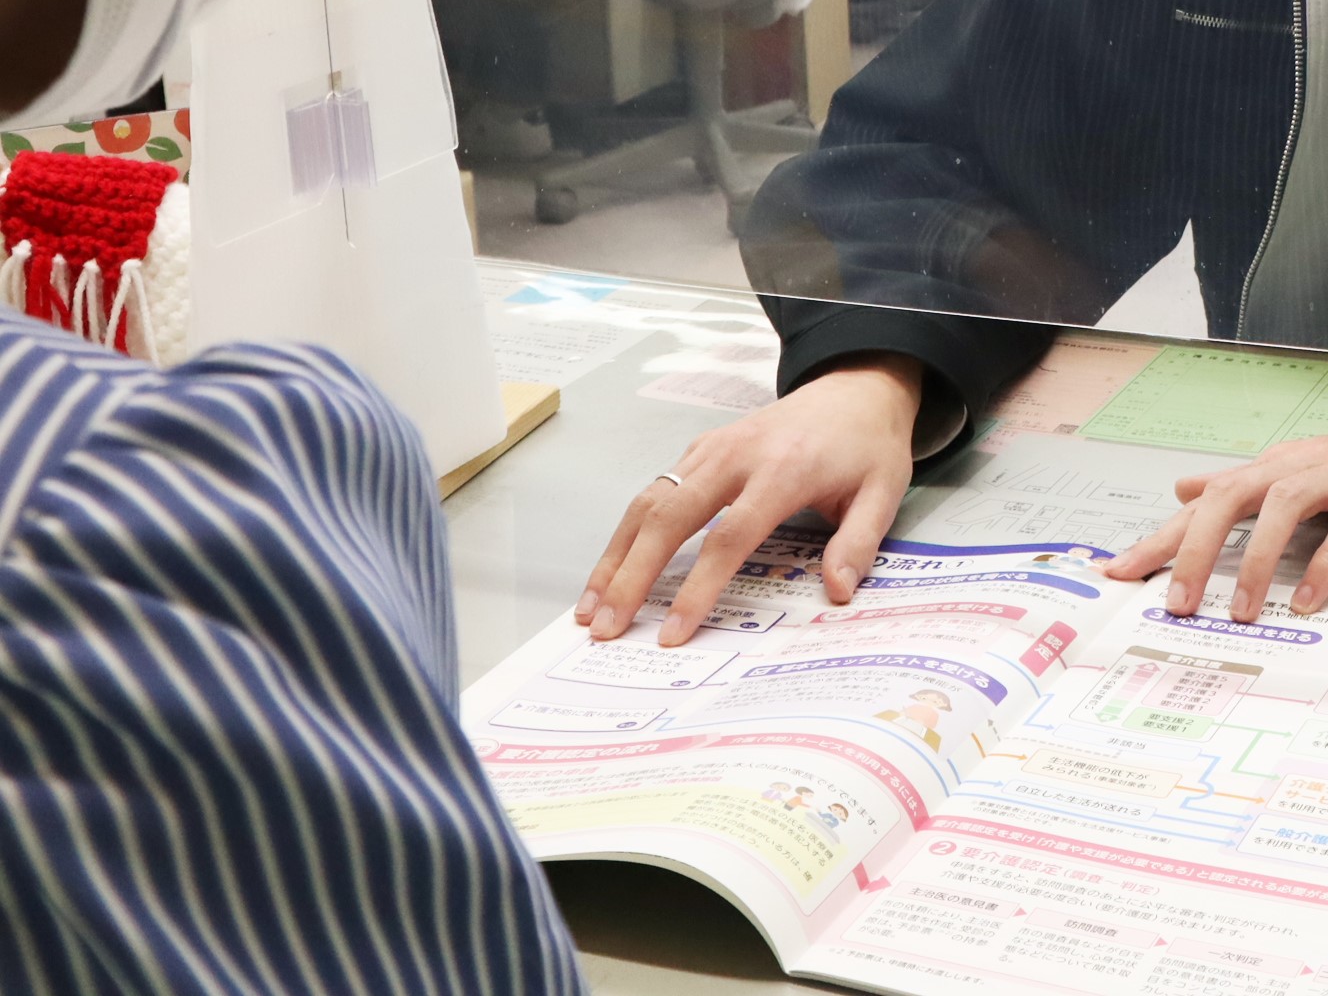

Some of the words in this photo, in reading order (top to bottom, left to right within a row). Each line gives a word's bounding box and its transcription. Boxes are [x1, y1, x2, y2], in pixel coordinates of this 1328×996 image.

[1034, 633, 1063, 662] 認定
[1015, 784, 1143, 817] 自立した生活が送れる
[909, 886, 1001, 912] 主治医の意見書
